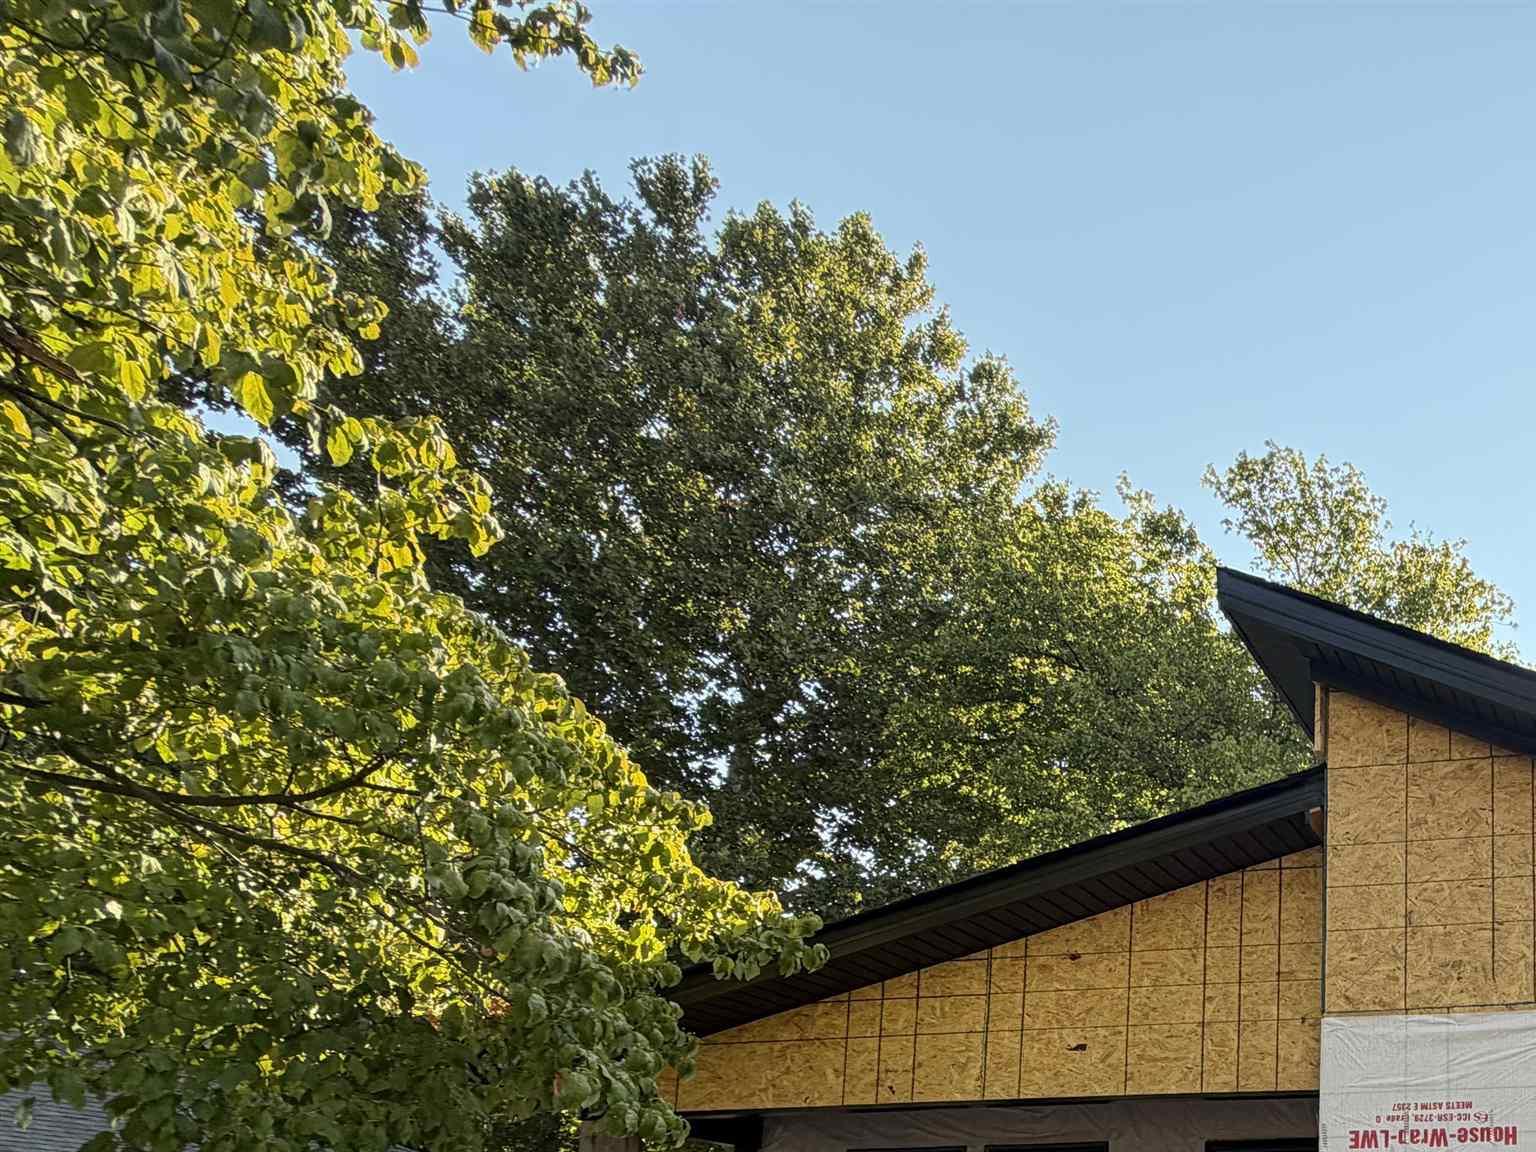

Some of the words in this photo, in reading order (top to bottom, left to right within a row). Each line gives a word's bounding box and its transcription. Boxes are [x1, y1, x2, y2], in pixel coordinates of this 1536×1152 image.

[1392, 1103, 1411, 1112] 2357
[1420, 1102, 1443, 1110] ASTM
[1445, 1101, 1472, 1110] MEETS
[1348, 1126, 1518, 1149] House-Wrap-LWE
